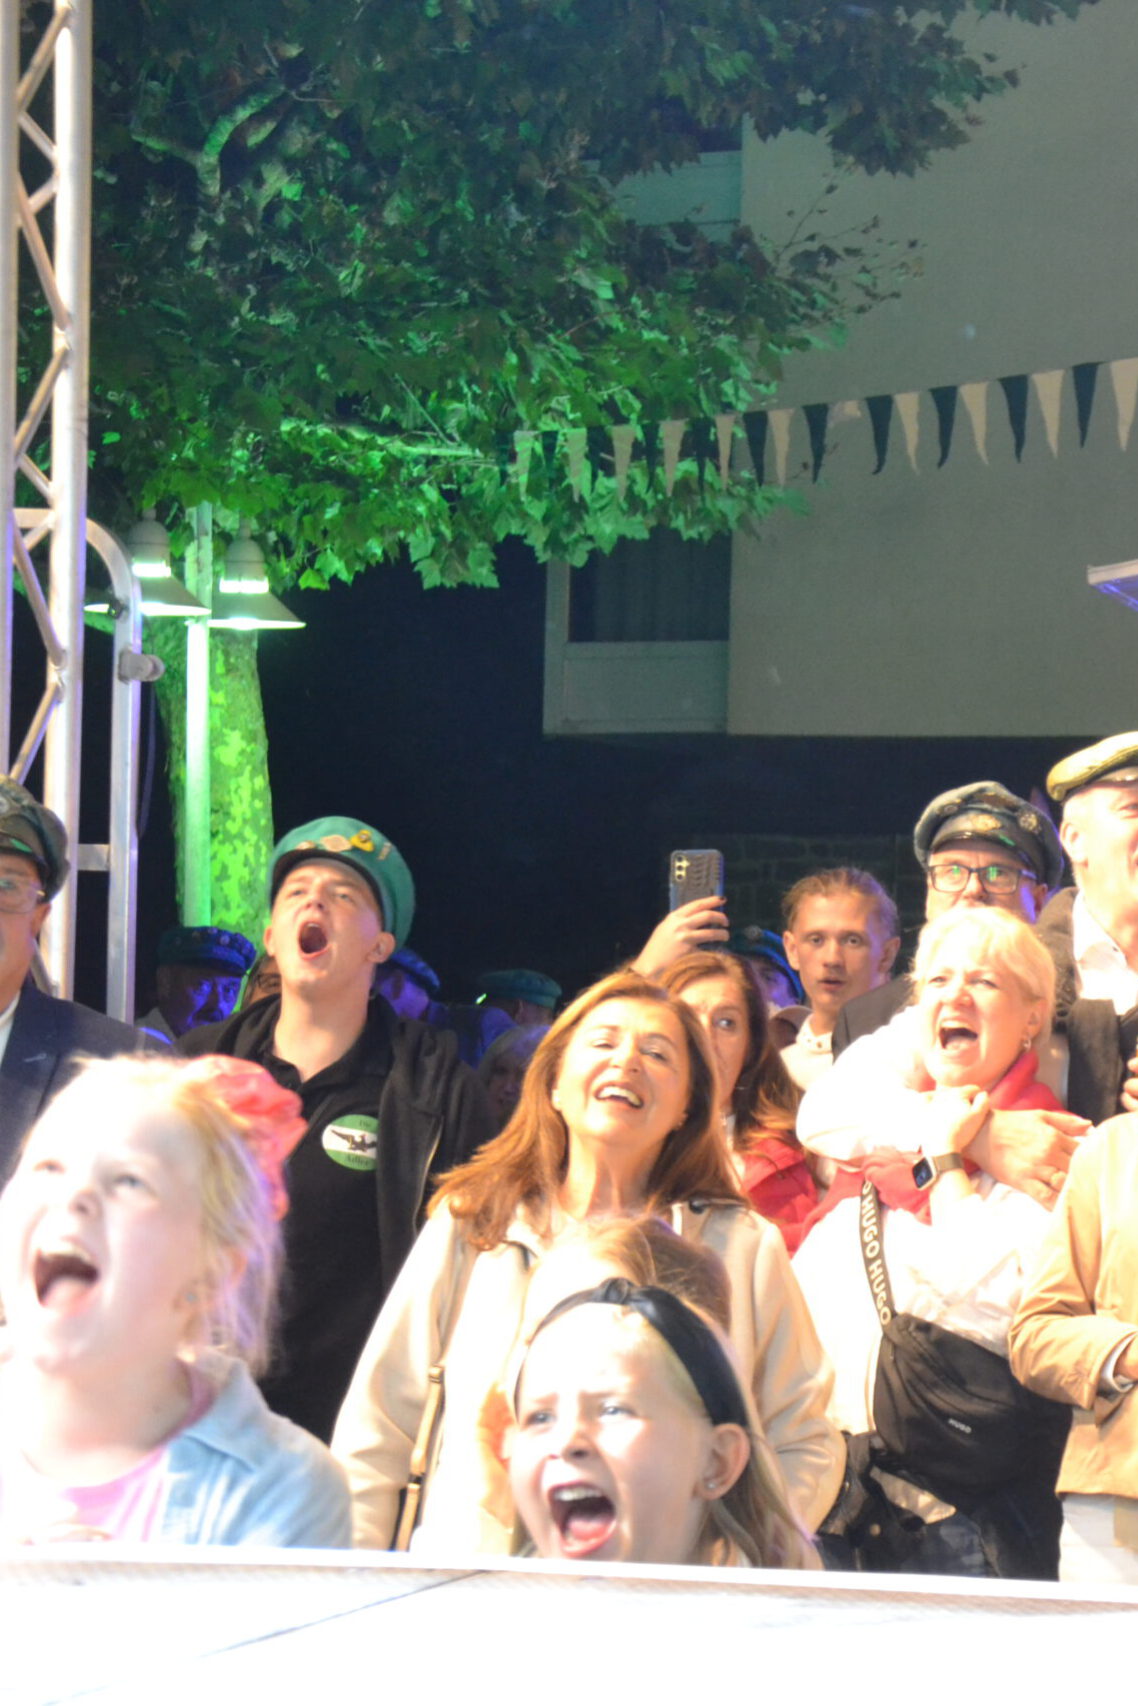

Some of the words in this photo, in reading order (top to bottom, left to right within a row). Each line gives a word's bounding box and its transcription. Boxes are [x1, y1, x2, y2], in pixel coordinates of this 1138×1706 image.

[861, 1194, 880, 1258] HUGO
[868, 1259, 892, 1325] HUGO
[948, 1418, 972, 1434] HUGO
